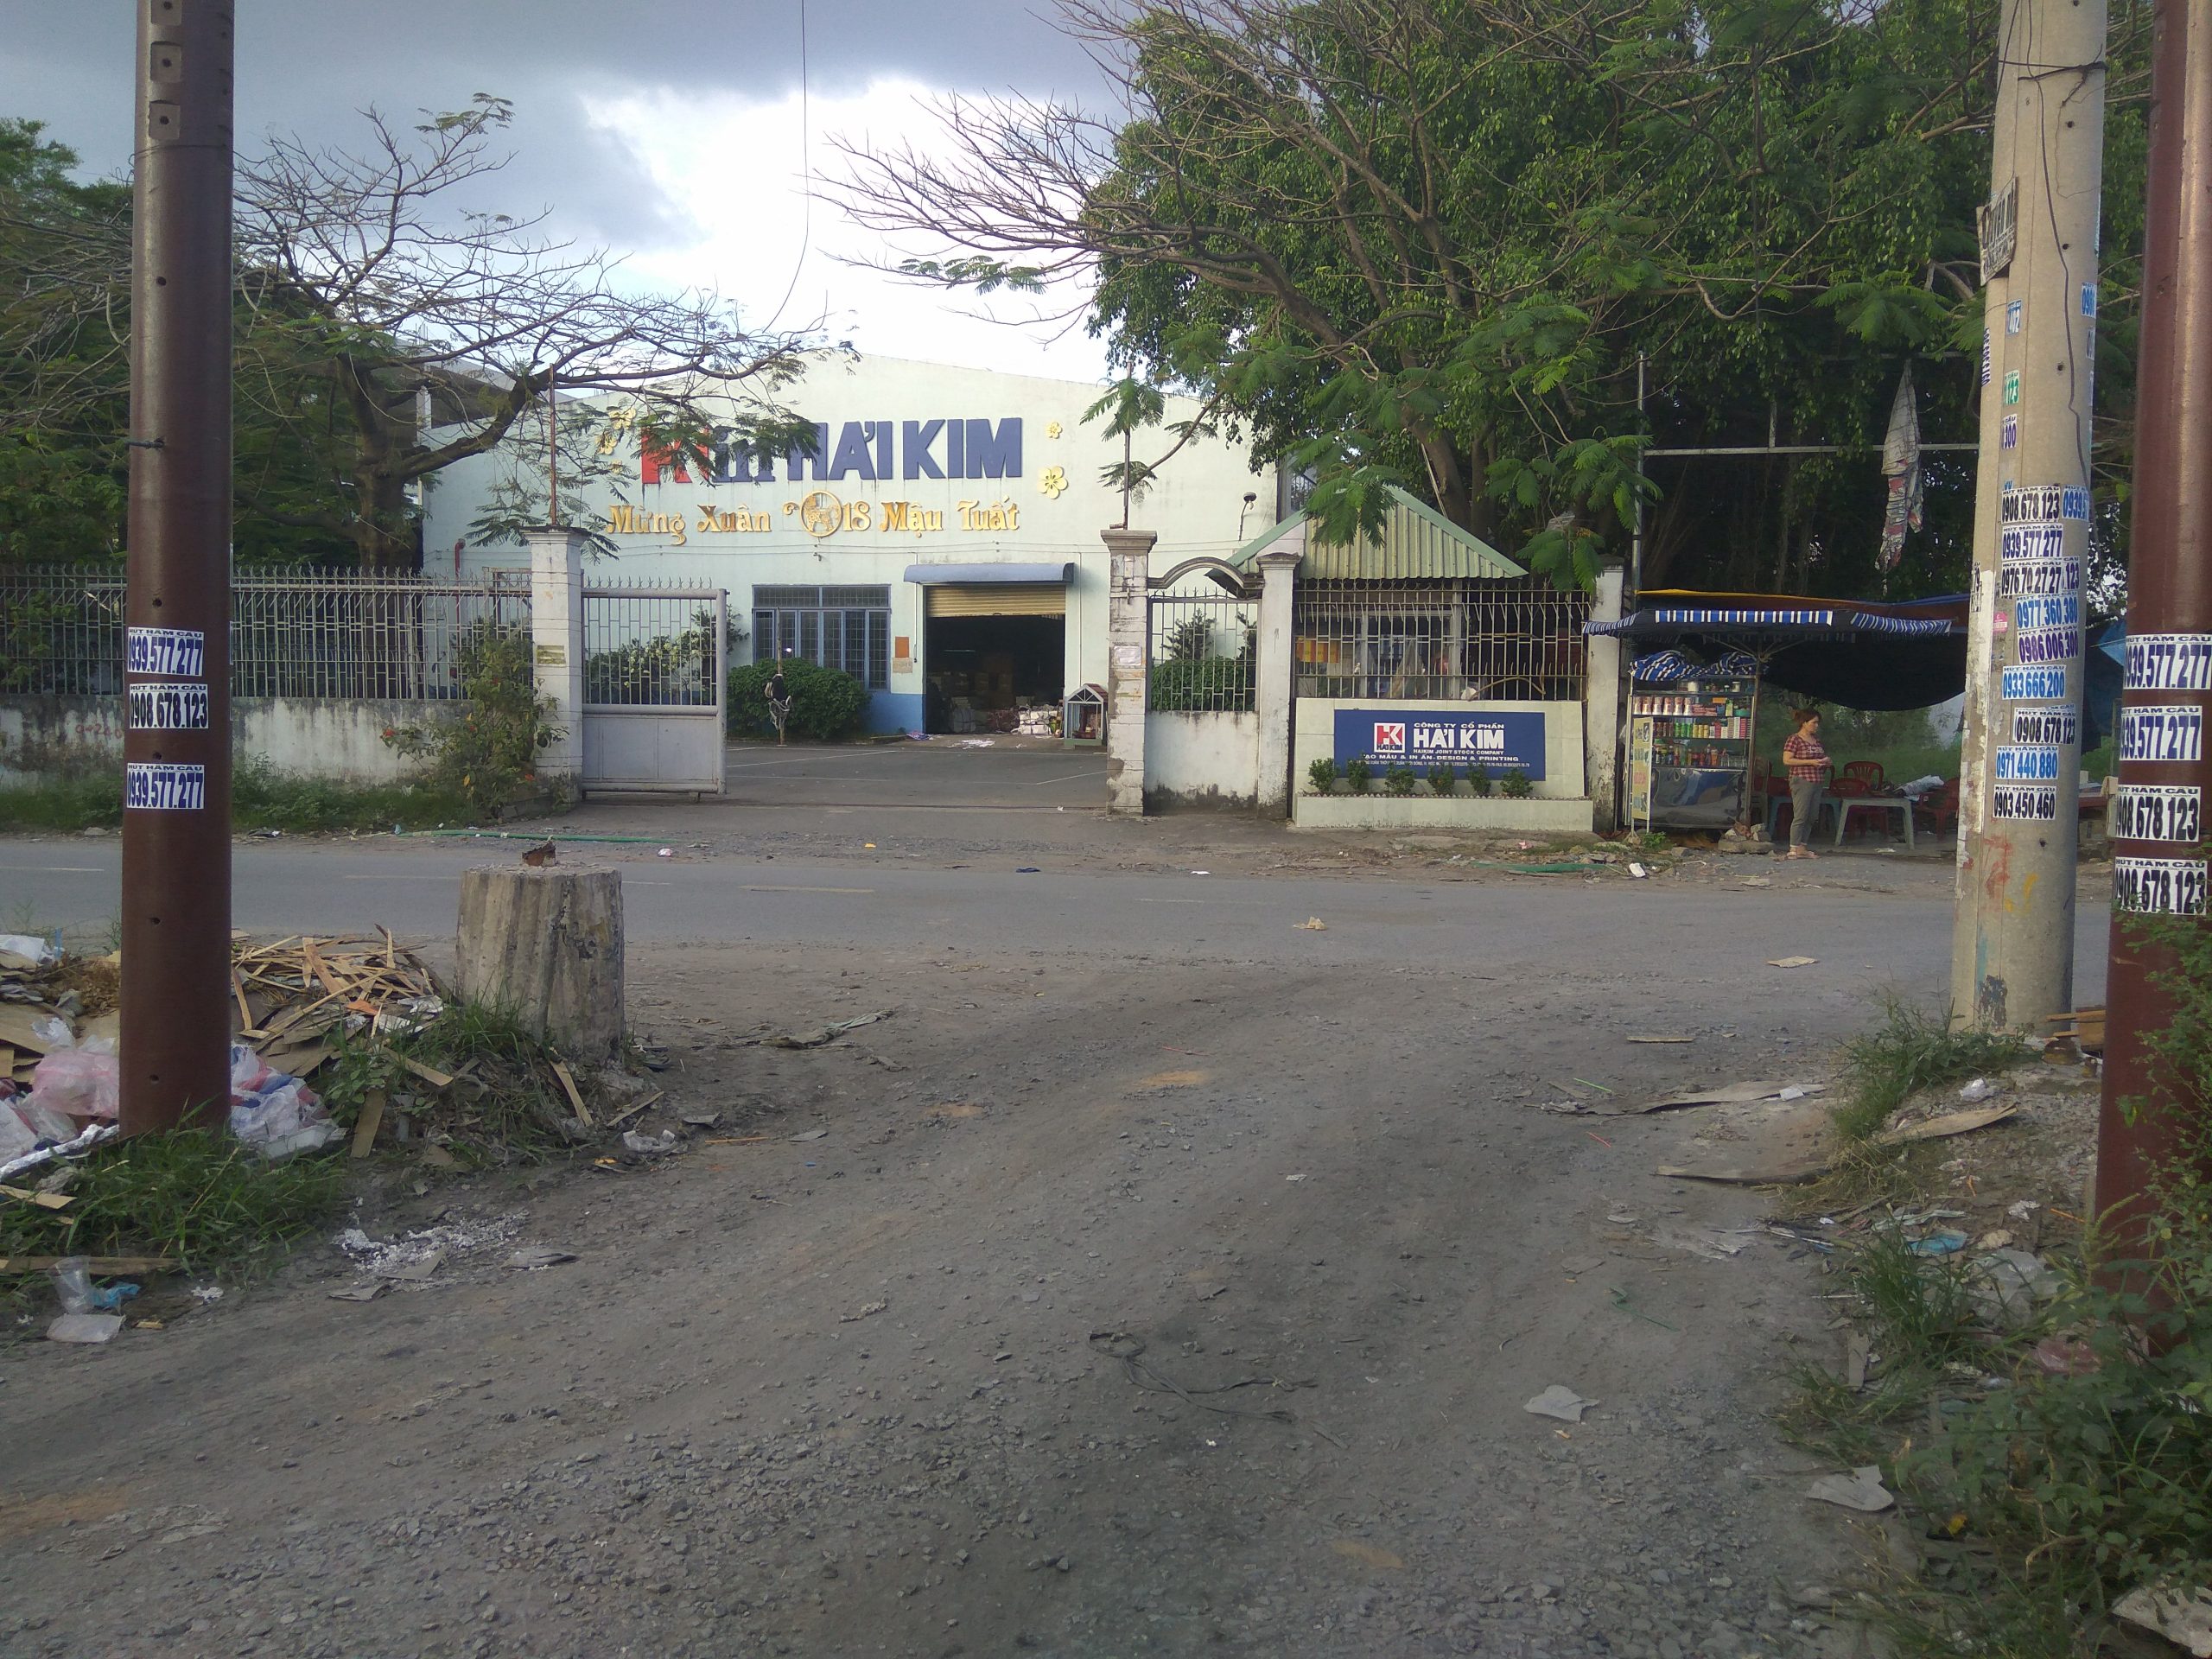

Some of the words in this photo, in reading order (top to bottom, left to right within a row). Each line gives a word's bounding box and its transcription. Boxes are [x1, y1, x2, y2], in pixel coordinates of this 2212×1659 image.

[903, 417, 1022, 479] KIM
[697, 503, 772, 532] Xuân
[879, 500, 943, 538] Mậu
[2002, 492, 2060, 522] 0908.678.123
[2002, 530, 2062, 559] 0939.577.277
[2002, 567, 2061, 594] 0976.70.27.27
[2017, 596, 2078, 628] 0977.360.380
[2018, 630, 2078, 663] 0986.006.300
[2125, 644, 2211, 688] 939.577.277
[2003, 671, 2065, 698] 0933.666.200
[130, 691, 207, 728] 0908.678.123
[1460, 729, 1504, 749] KIM
[2016, 716, 2075, 744] 0908.678.123
[1997, 752, 2057, 779] 0971.440.880
[1993, 791, 2055, 819] 0903.450.460
[2116, 796, 2199, 840] 908.678.123
[2116, 868, 2205, 914] 908.678.123
